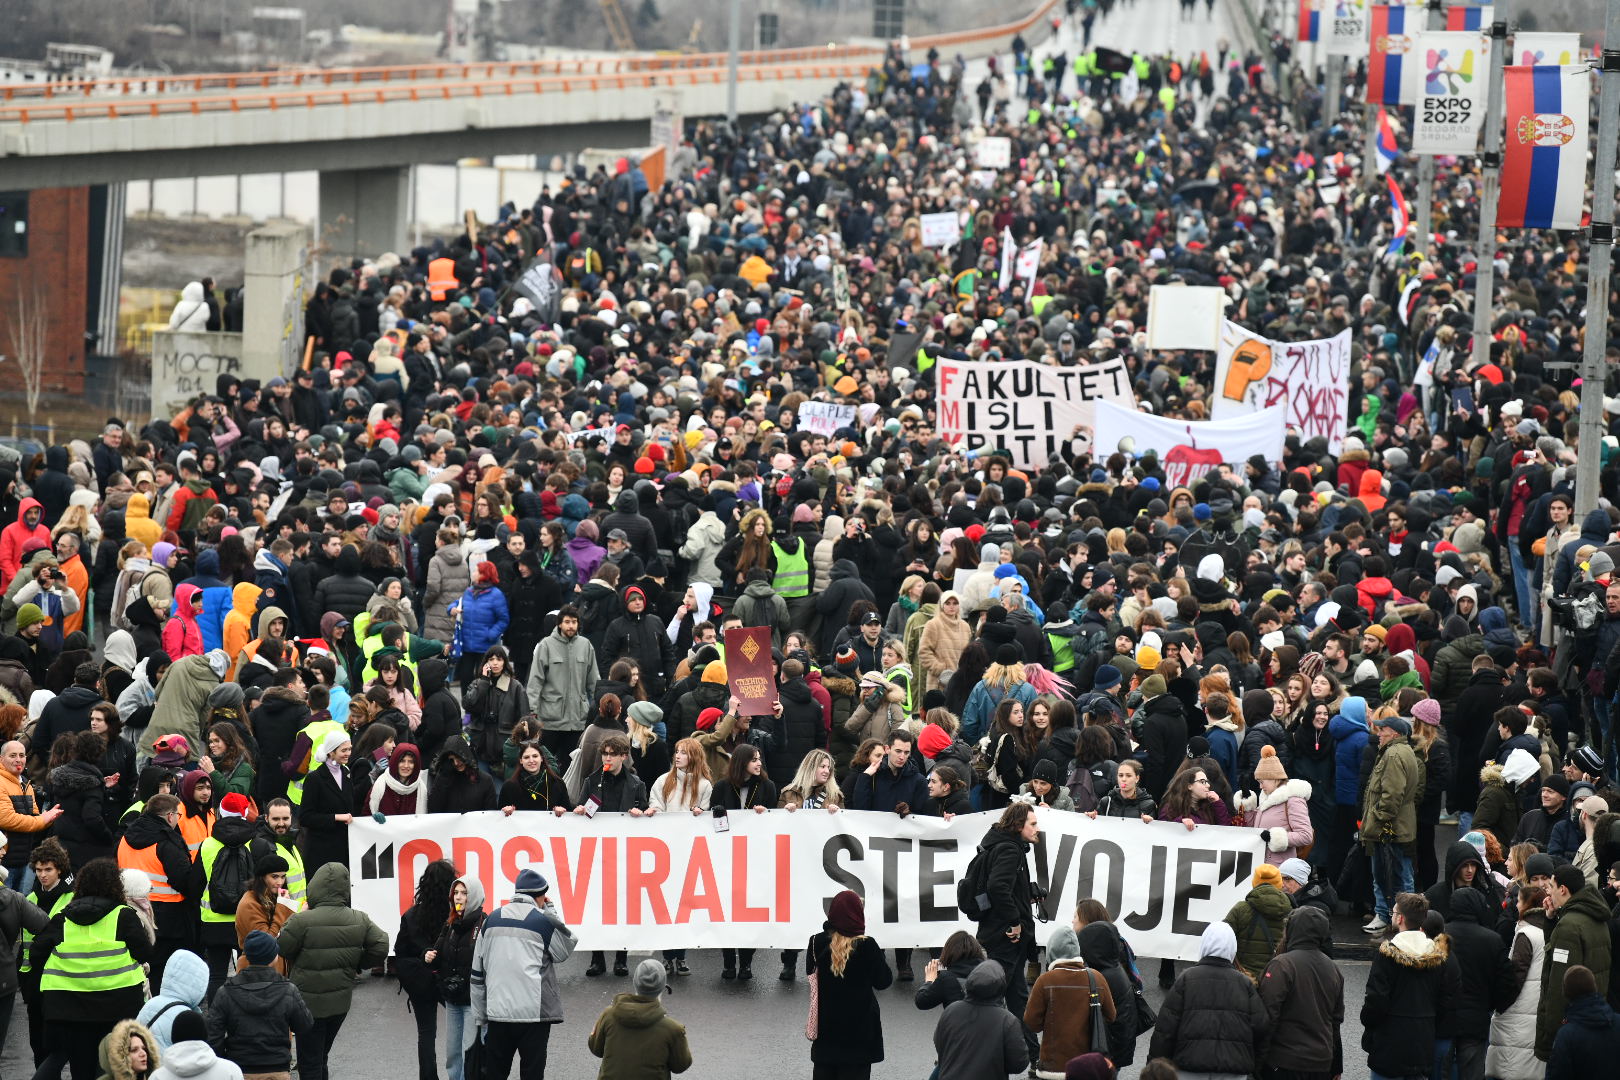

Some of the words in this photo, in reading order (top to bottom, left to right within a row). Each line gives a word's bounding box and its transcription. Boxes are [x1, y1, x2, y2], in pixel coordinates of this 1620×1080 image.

[1423, 111, 1471, 123] 2027
[1424, 98, 1472, 110] EXPO
[941, 366, 1122, 401] FAKULTET
[941, 400, 1054, 430] MISLI
[822, 833, 959, 923] STE
